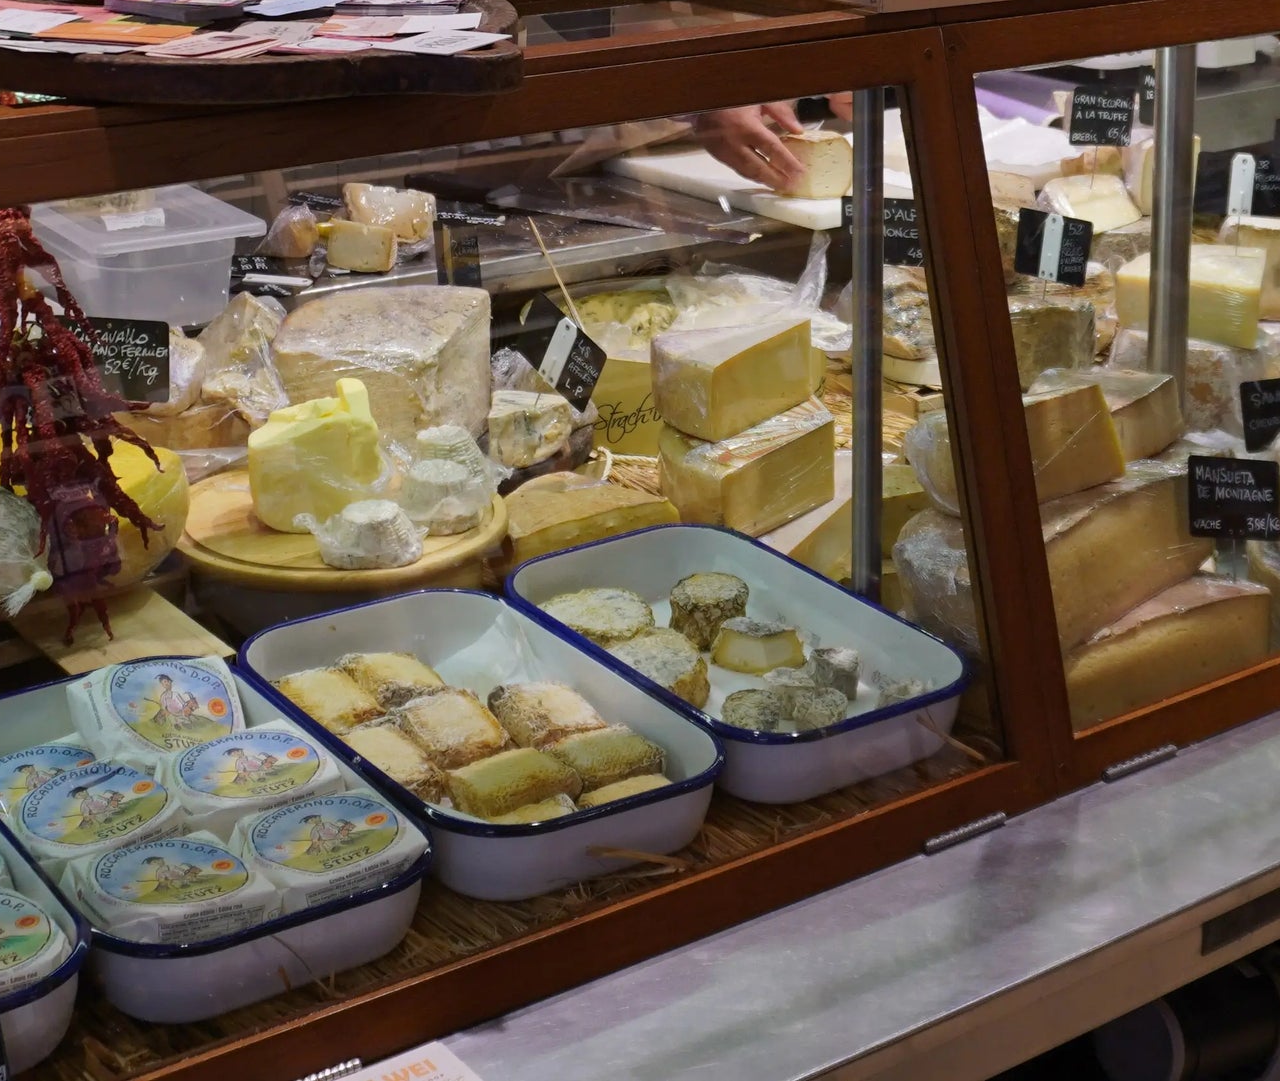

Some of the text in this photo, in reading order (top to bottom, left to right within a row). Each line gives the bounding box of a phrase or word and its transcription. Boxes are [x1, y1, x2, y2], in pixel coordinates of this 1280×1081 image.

[1085, 111, 1128, 122] LA TRUFFE
[1195, 467, 1254, 485] MANSUETA
[1215, 488, 1273, 501] MONTAGNE
[1194, 520, 1221, 529] VACHE
[184, 733, 254, 771] ROCCAVERANO
[257, 798, 334, 840] ROCCAVERANO
[99, 841, 176, 881] ROCCAVERANO
[321, 847, 372, 870] STUTZ
